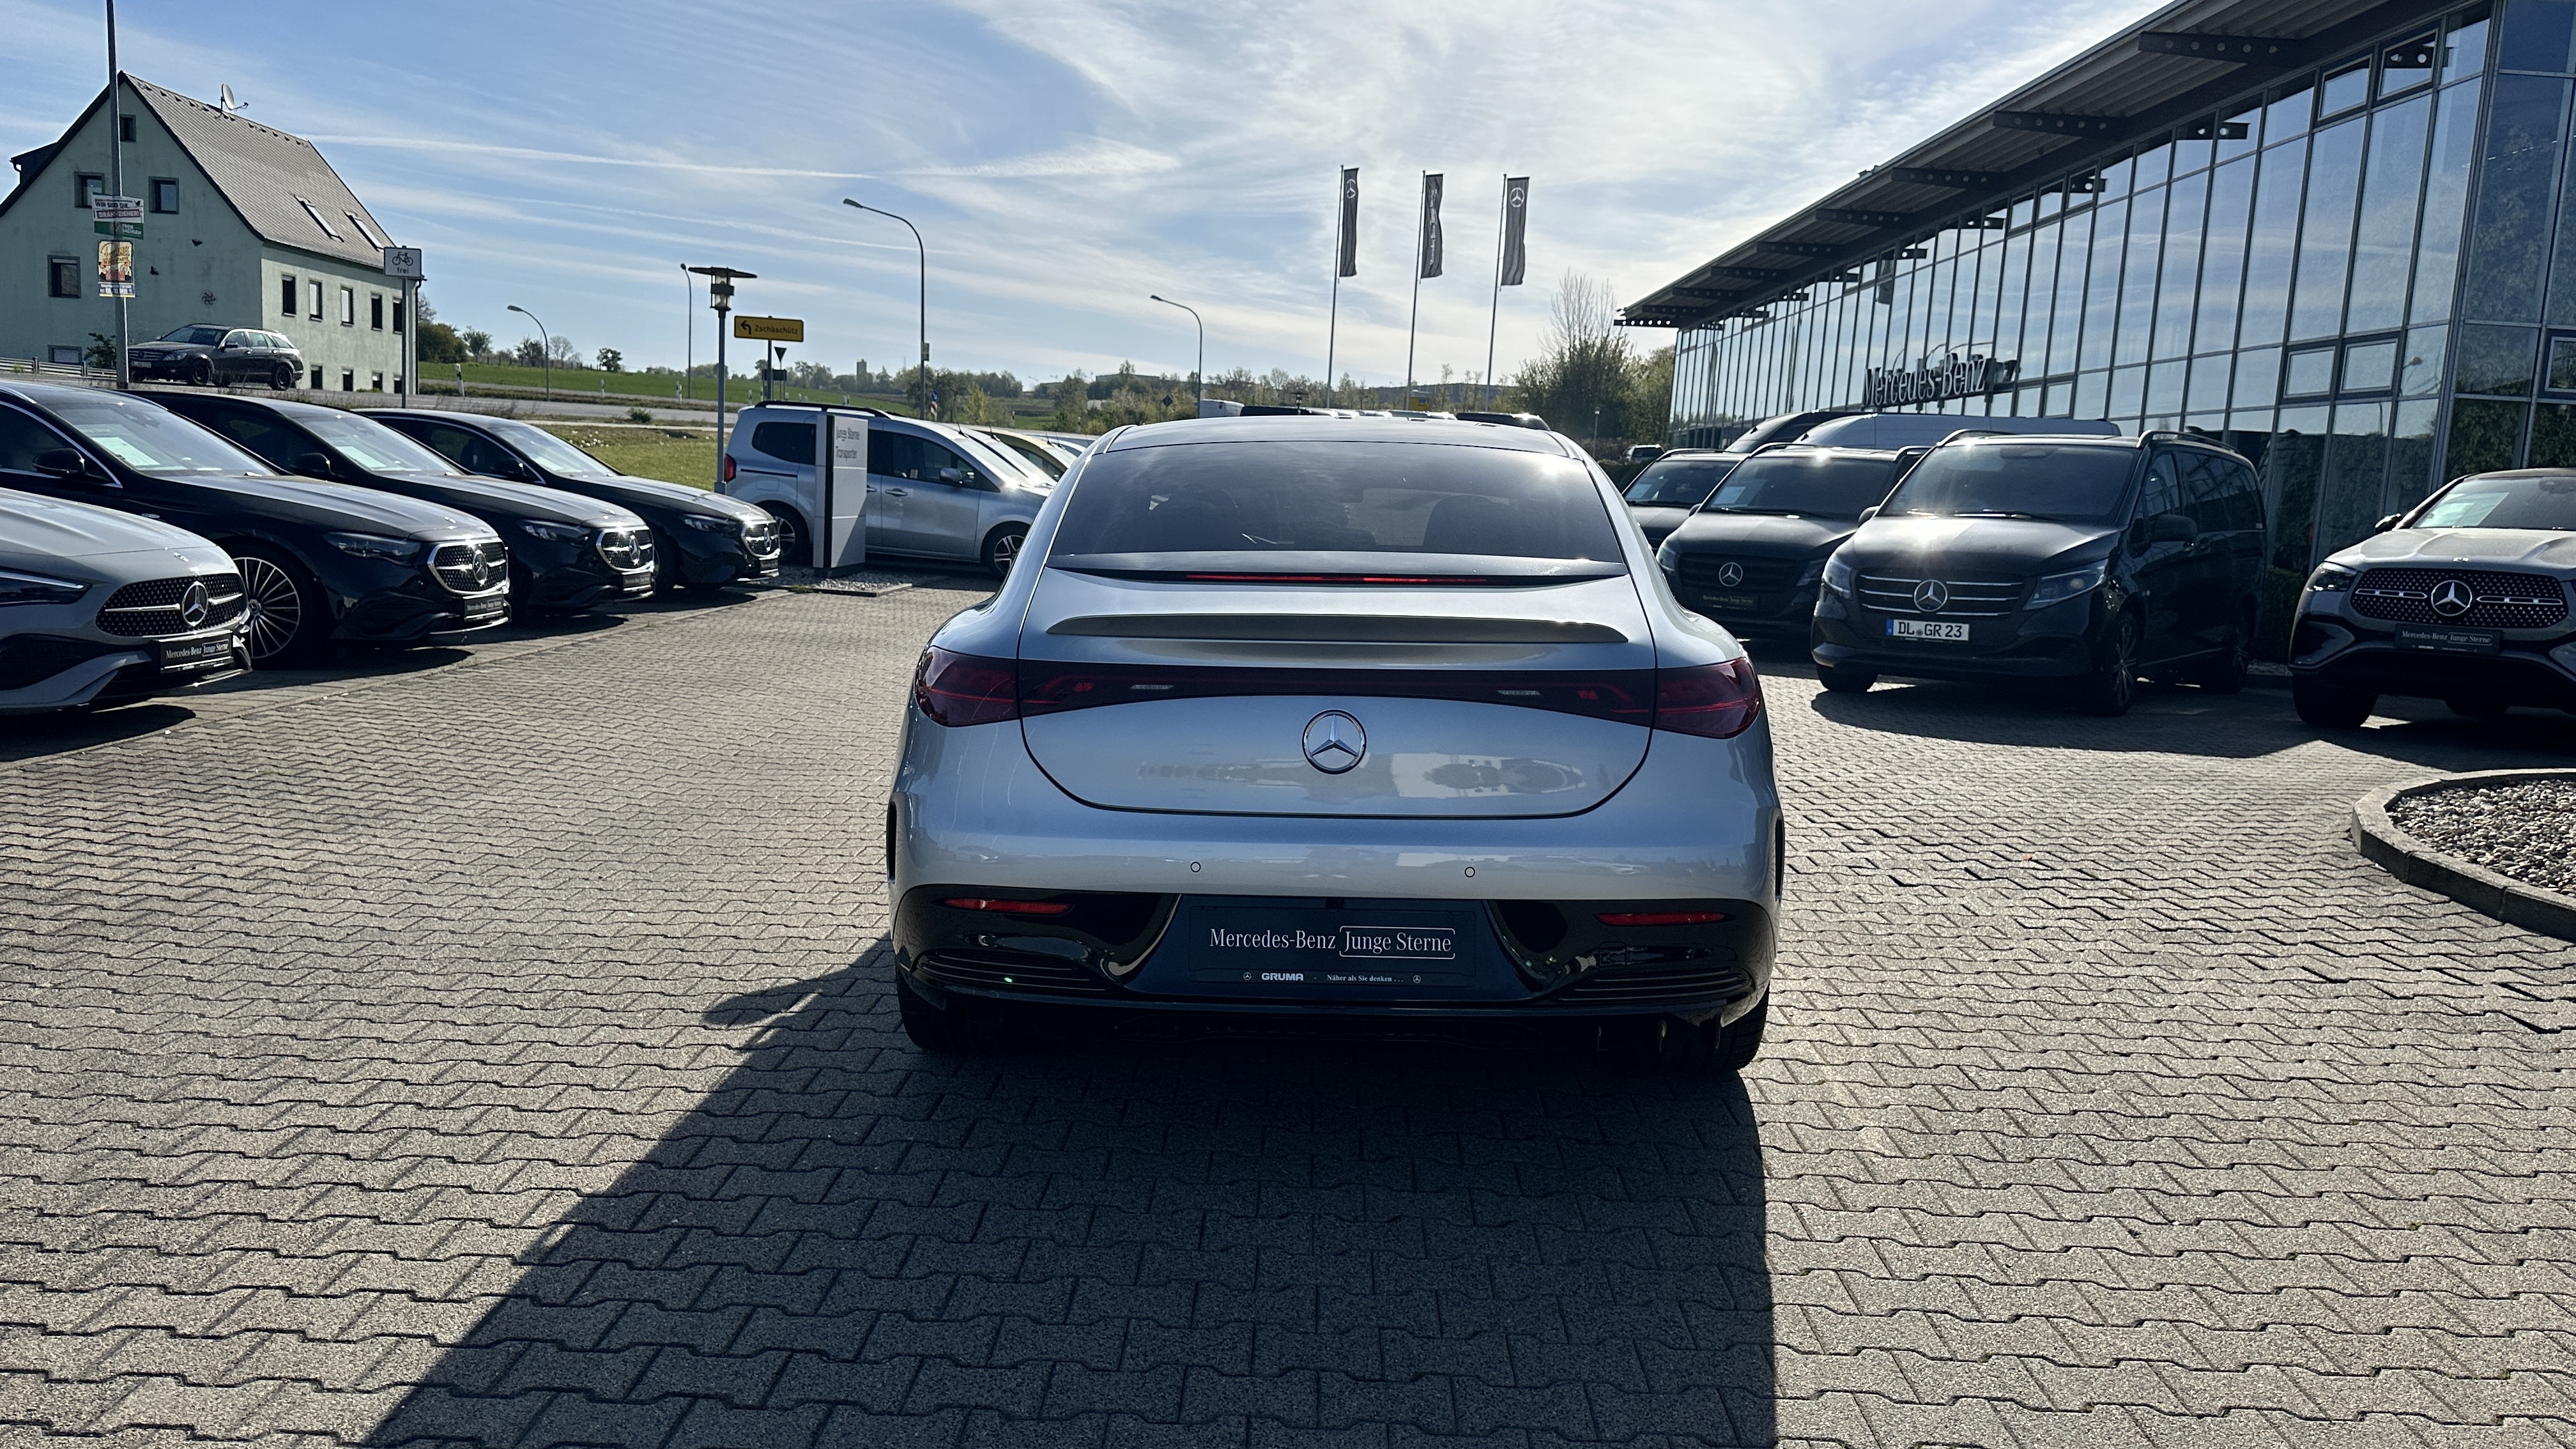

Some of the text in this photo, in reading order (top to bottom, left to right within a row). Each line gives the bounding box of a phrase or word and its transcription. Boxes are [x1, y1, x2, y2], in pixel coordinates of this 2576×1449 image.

[1862, 353, 1987, 407] Mercedes-Benz
[1897, 622, 1915, 635] DL
[1924, 624, 1942, 637] GR
[1945, 625, 1963, 638] 23
[2402, 631, 2448, 641] Mercedes-Benz
[2450, 634, 2468, 642] Junge
[166, 647, 202, 659] Mercedes-Benz
[1209, 928, 1452, 954] Mercedes-Benz Junge Sterne
[1261, 972, 1304, 981] GRUMA
